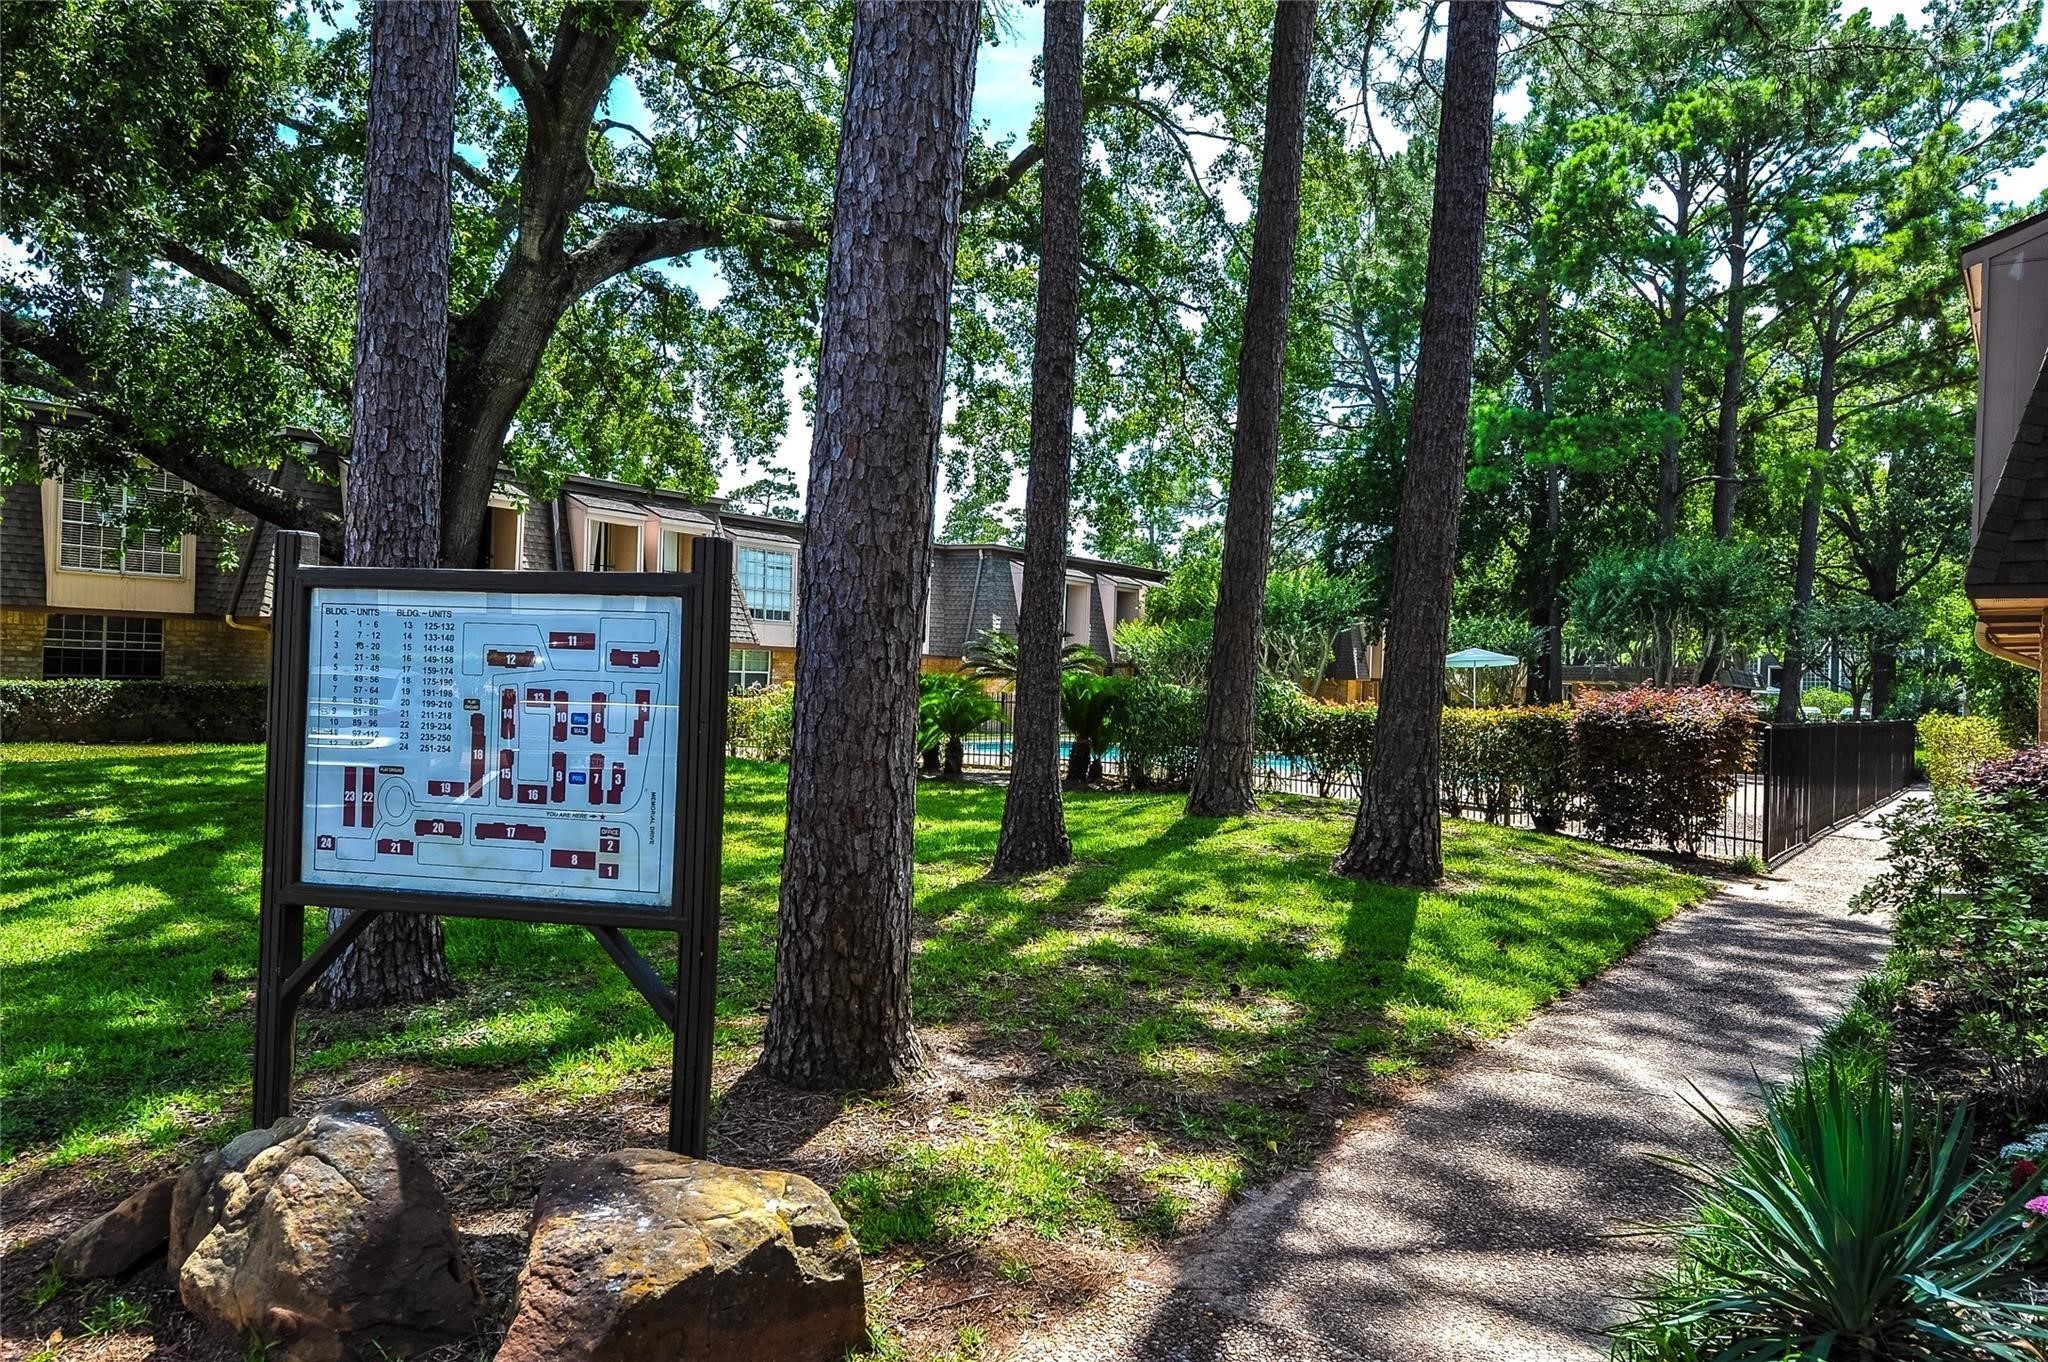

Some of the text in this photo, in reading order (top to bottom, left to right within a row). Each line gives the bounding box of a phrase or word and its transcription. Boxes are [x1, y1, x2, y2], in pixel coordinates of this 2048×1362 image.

[326, 608, 349, 616] BLDG.
[356, 608, 380, 616] UNITS
[396, 609, 420, 617] BLDG.
[428, 610, 452, 618] UNITS
[424, 634, 454, 642] 133-140
[568, 635, 577, 646] 11
[424, 644, 454, 653] 141-148
[423, 656, 454, 664] 149-158
[506, 654, 516, 665] 12
[632, 654, 638, 664] 5
[423, 667, 453, 675] 159-174
[422, 700, 452, 708] 199-210
[421, 711, 452, 719] 211-218
[503, 709, 512, 719] 14
[557, 712, 567, 723] 10
[594, 712, 601, 723] 6
[421, 722, 452, 730] 219-234
[420, 733, 451, 741] 235-250
[420, 744, 450, 752] 251-254
[473, 750, 483, 759] 18
[501, 769, 510, 779] 15
[556, 771, 562, 781] 9
[594, 774, 599, 784] 7
[615, 774, 621, 784] 3
[440, 783, 450, 793] 19
[345, 791, 355, 802] 23
[363, 792, 373, 802] 22
[528, 790, 538, 800] 16
[432, 823, 444, 833] 20
[506, 827, 515, 838] 17
[321, 838, 332, 848] 24
[391, 843, 400, 853] 21
[607, 841, 614, 851] 2
[572, 855, 578, 865] 8
[608, 866, 612, 876] 1
